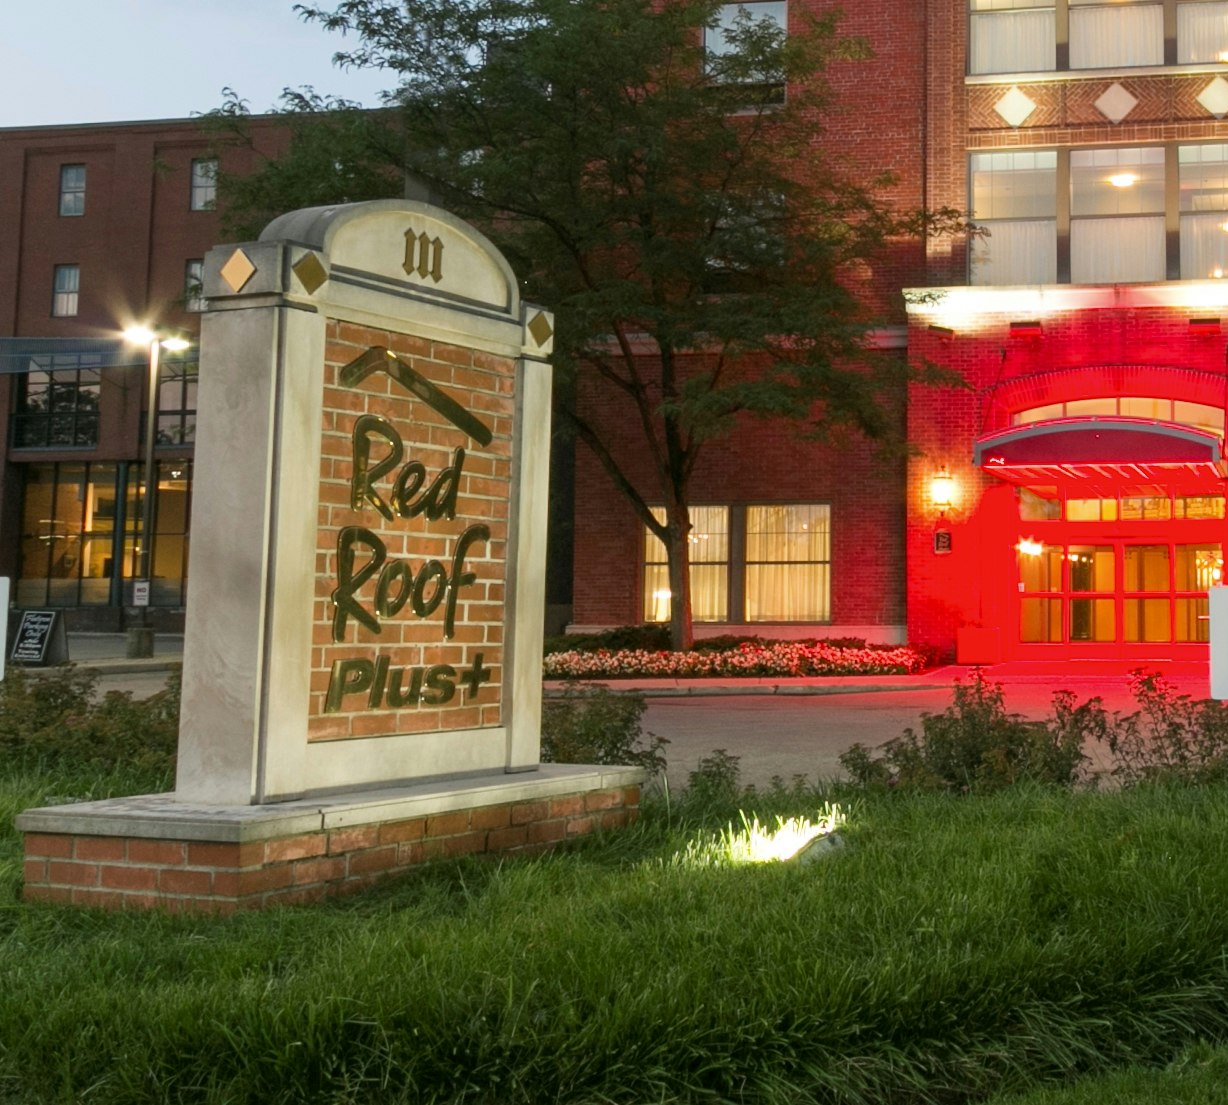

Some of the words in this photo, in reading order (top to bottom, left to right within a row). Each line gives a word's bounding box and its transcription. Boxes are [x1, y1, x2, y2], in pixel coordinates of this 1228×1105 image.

[351, 414, 465, 522] Red
[331, 523, 490, 643] Roof
[325, 652, 491, 714] Plus+
